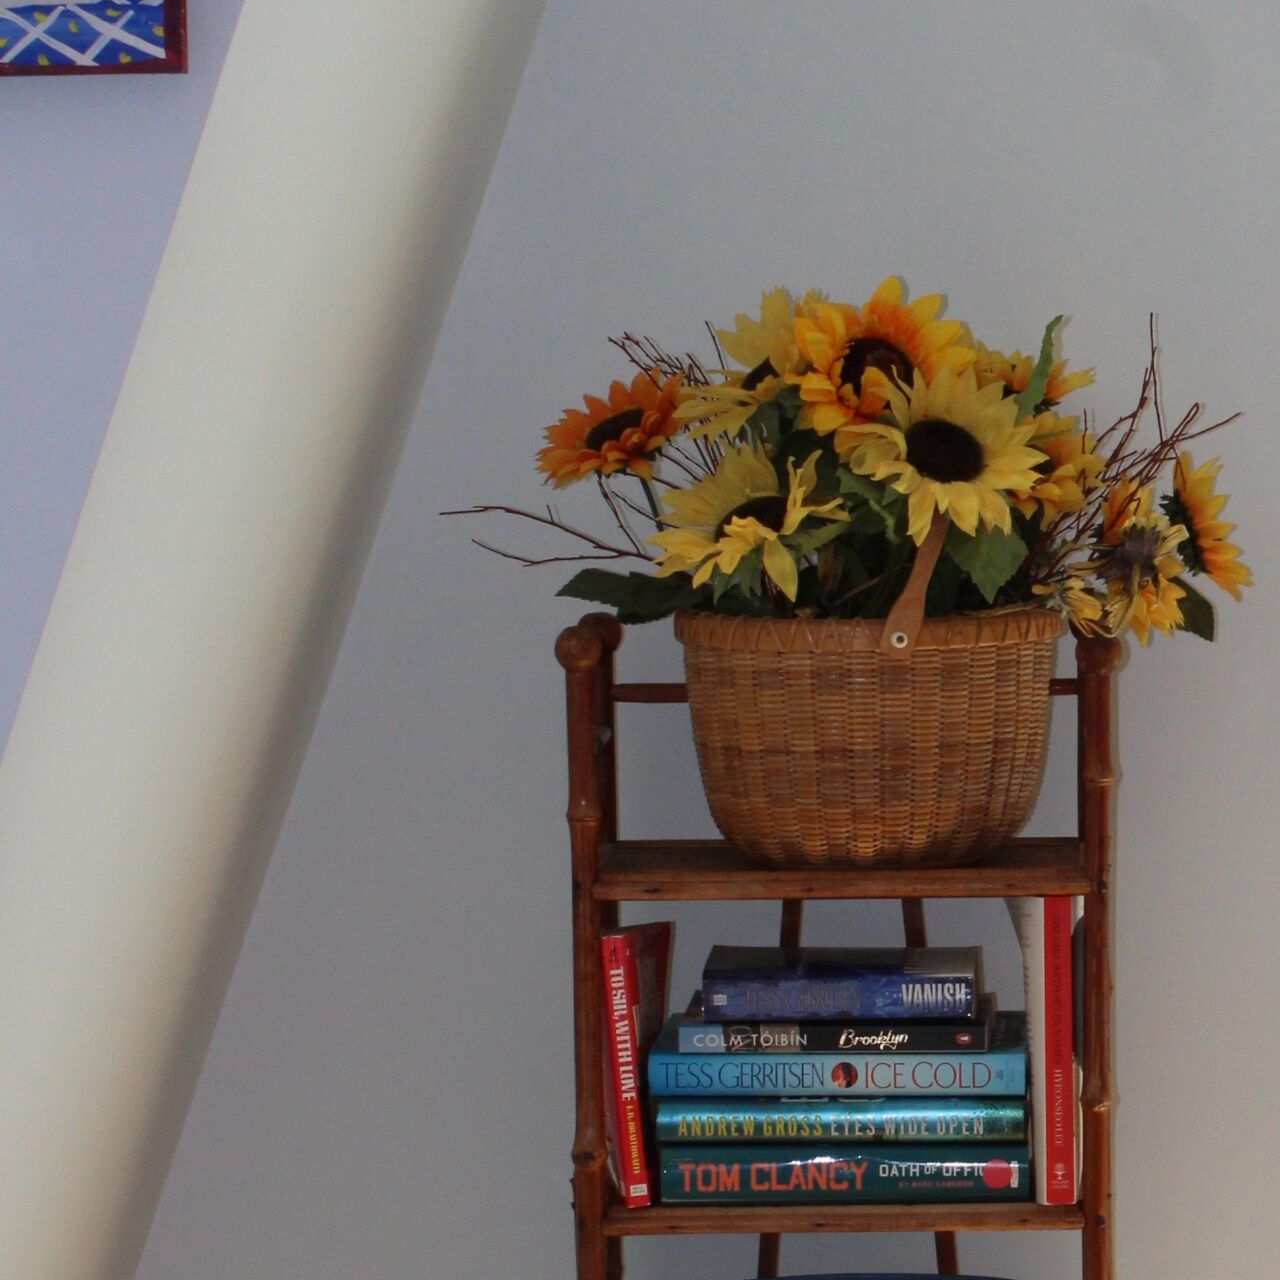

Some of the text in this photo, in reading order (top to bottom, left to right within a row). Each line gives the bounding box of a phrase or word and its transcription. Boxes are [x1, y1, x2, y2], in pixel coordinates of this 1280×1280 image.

[902, 983, 966, 1010] VANISH
[609, 966, 637, 1101] TO SIR, WITH LOVE
[693, 1029, 808, 1047] COLM TÓIBÍN
[838, 1028, 909, 1050] Brooklyn
[658, 1061, 825, 1089] TESS GERRITSEN
[864, 1061, 906, 1089] ICE
[911, 1061, 993, 1089] COLD
[678, 1114, 823, 1137] ANDREW GROSS
[830, 1115, 985, 1136] EYES WIDE OPEN
[1054, 1128, 1065, 1147] LEE
[678, 1161, 740, 1193] TOM
[749, 1161, 869, 1192] CLANCY
[878, 1163, 920, 1177] OATH
[924, 1163, 939, 1175] OF
